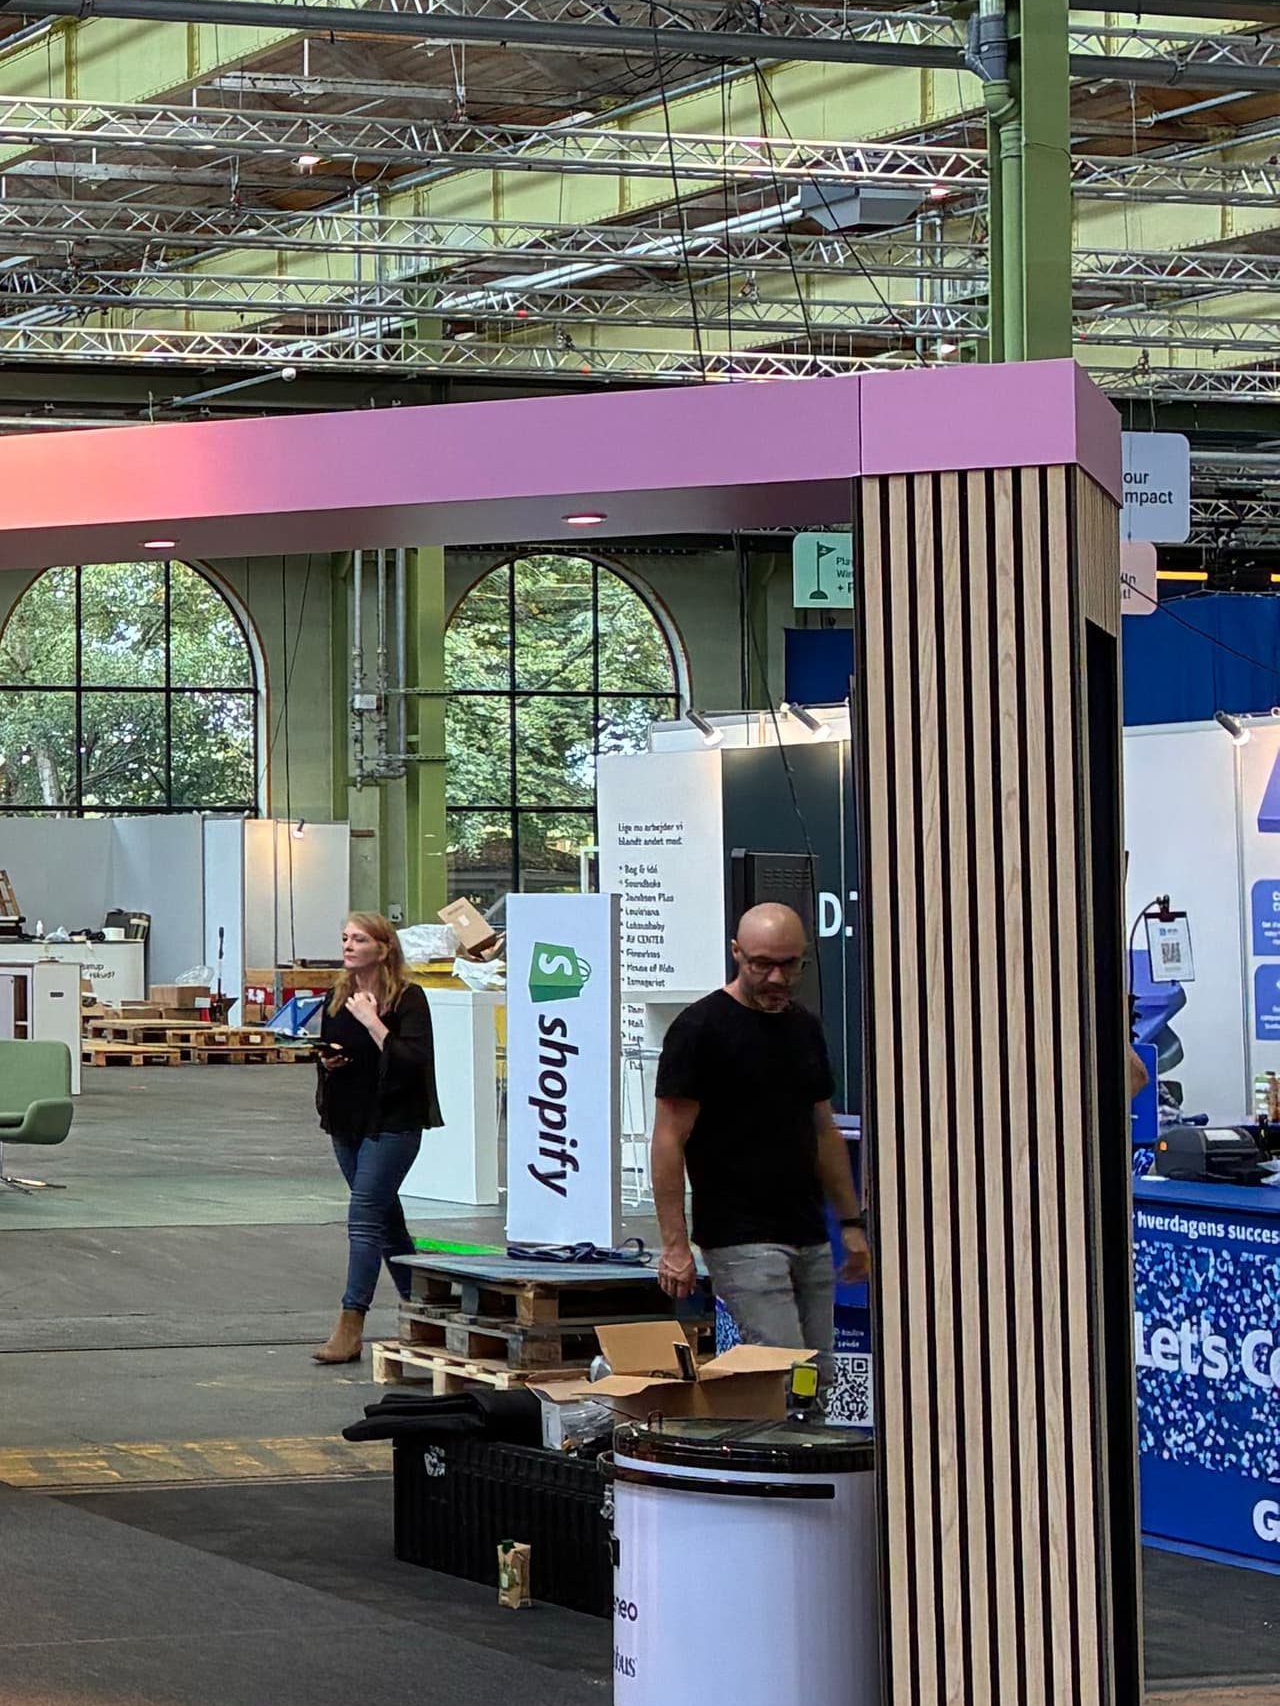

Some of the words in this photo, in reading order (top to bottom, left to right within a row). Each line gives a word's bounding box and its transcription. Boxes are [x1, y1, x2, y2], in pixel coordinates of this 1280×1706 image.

[1124, 490, 1174, 506] mpact
[527, 1014, 579, 1198] shopify
[1137, 1210, 1225, 1239] hverdagens
